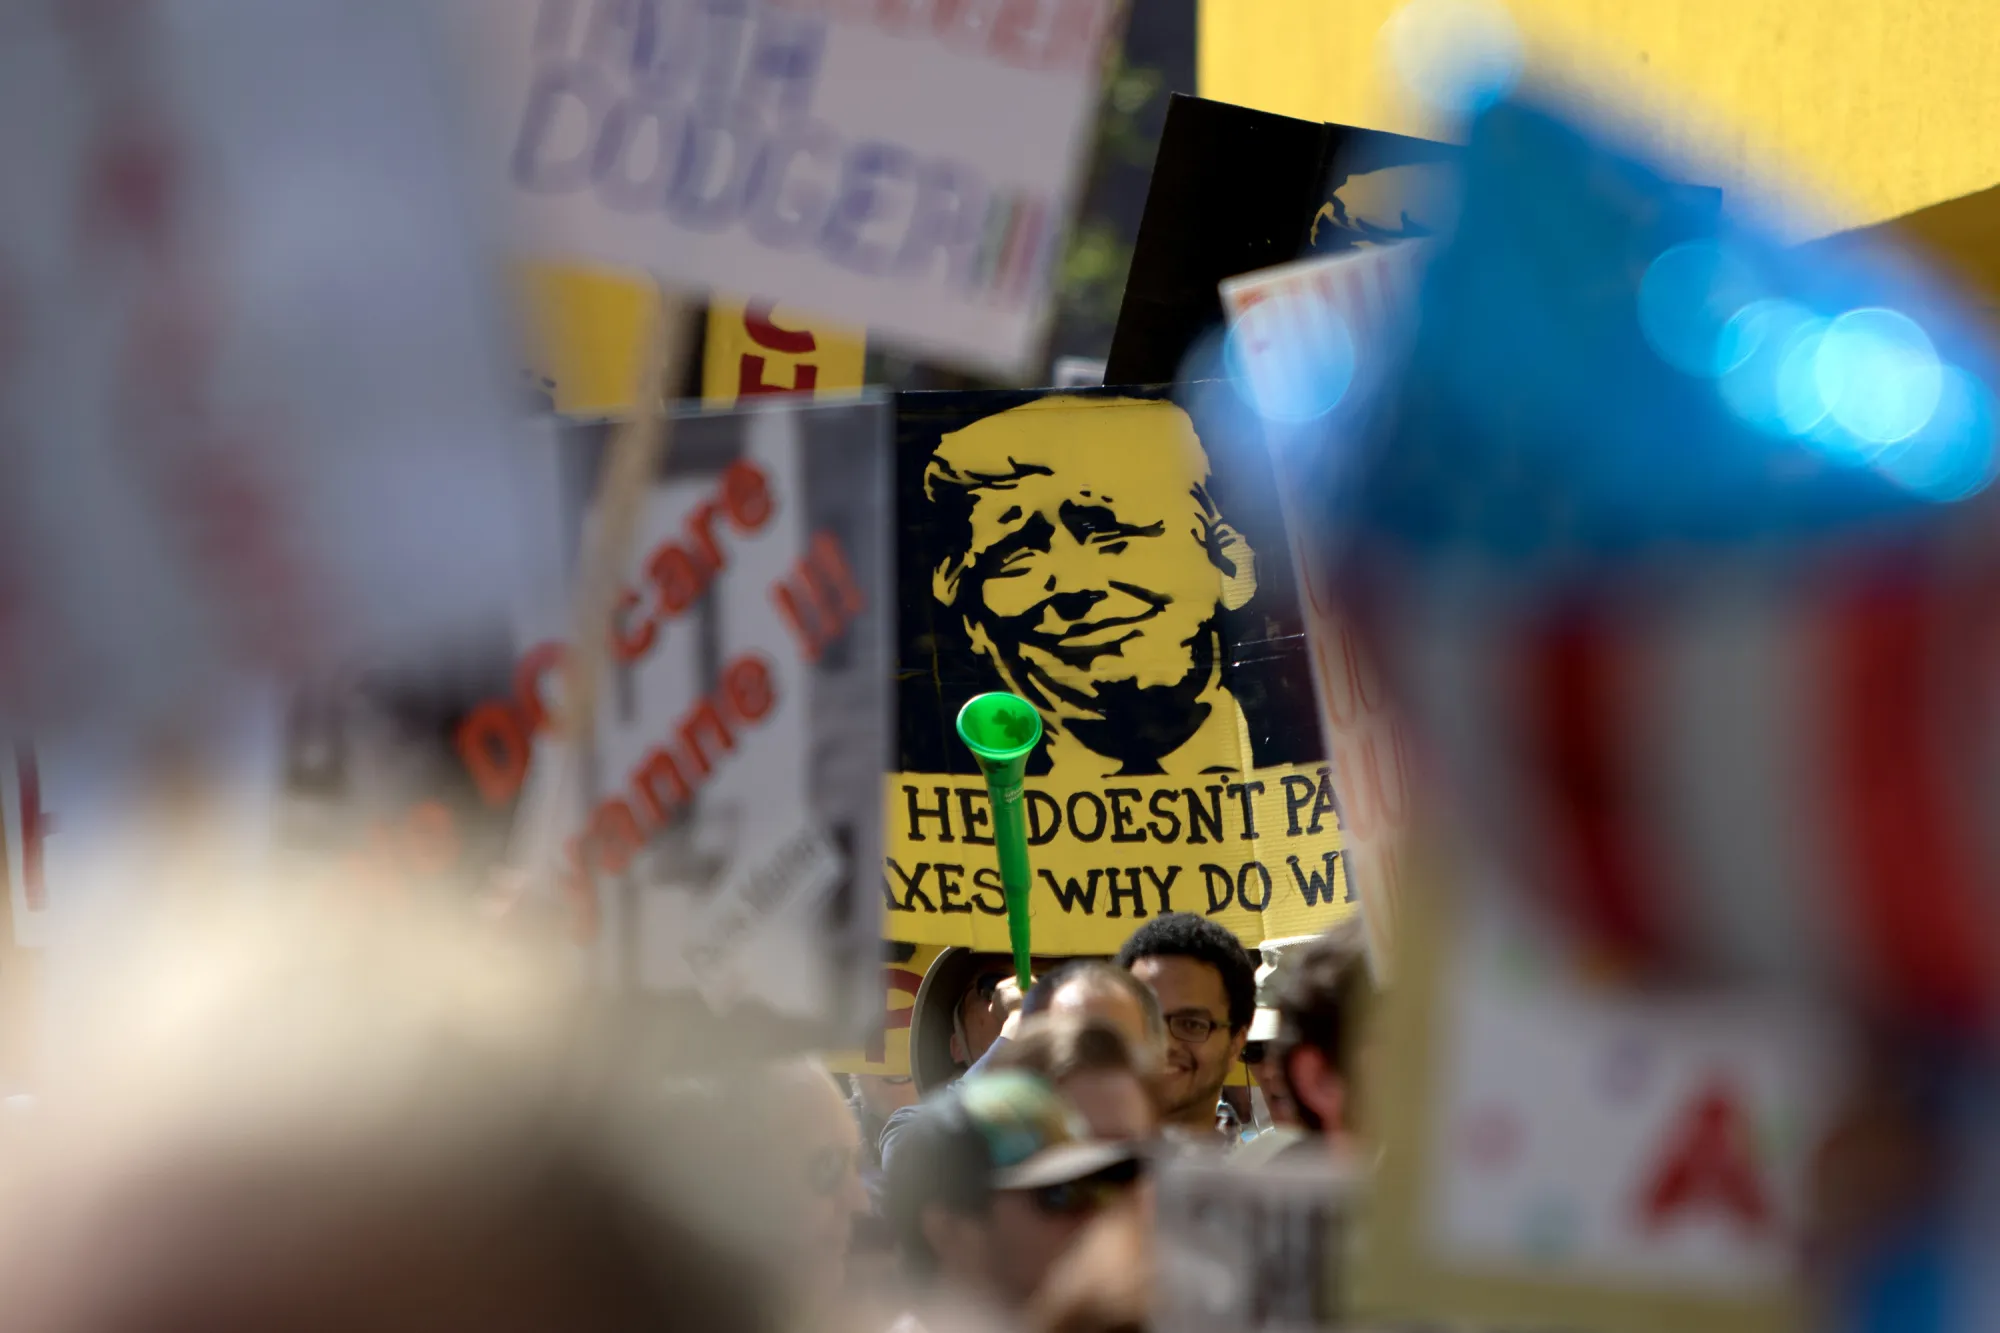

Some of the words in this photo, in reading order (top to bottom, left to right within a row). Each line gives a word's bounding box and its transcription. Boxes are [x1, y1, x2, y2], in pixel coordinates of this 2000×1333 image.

[610, 457, 776, 666] care
[902, 785, 995, 845] HE
[1023, 774, 1265, 845] DOESN'T
[882, 856, 1008, 916] XES
[1038, 864, 1183, 918] WHY
[1199, 861, 1273, 916] DO
